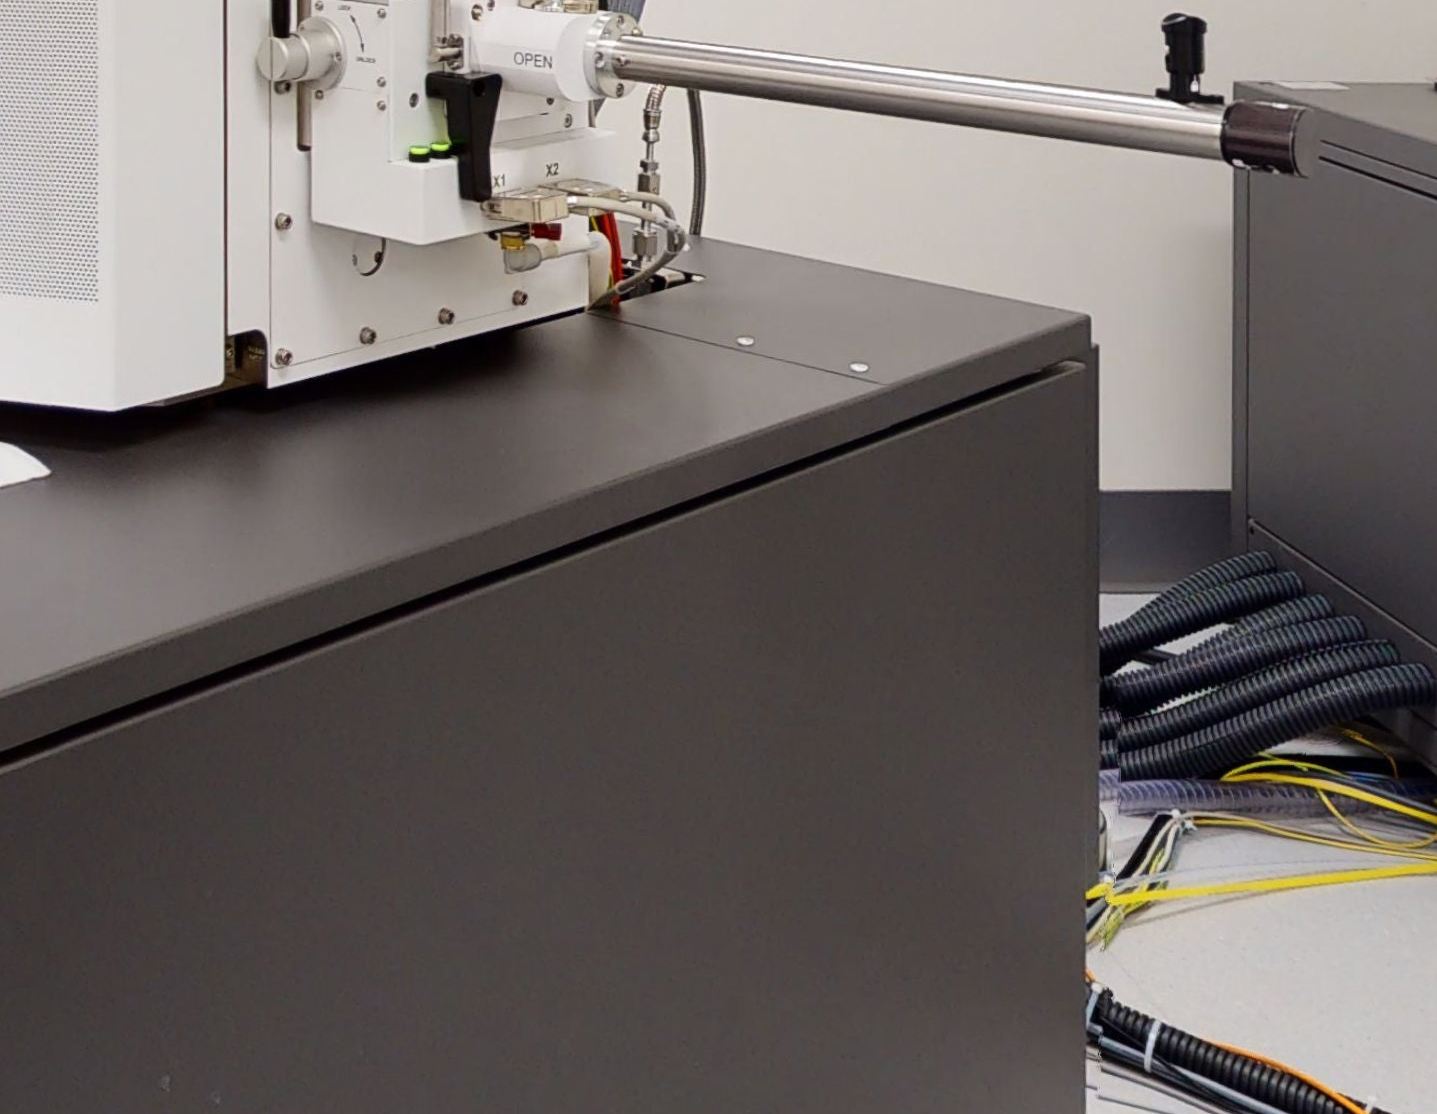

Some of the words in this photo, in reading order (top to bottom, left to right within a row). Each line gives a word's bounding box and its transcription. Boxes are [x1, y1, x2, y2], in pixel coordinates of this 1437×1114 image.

[513, 51, 553, 69] OPEN
[546, 162, 559, 177] X2
[493, 174, 506, 187] X1
